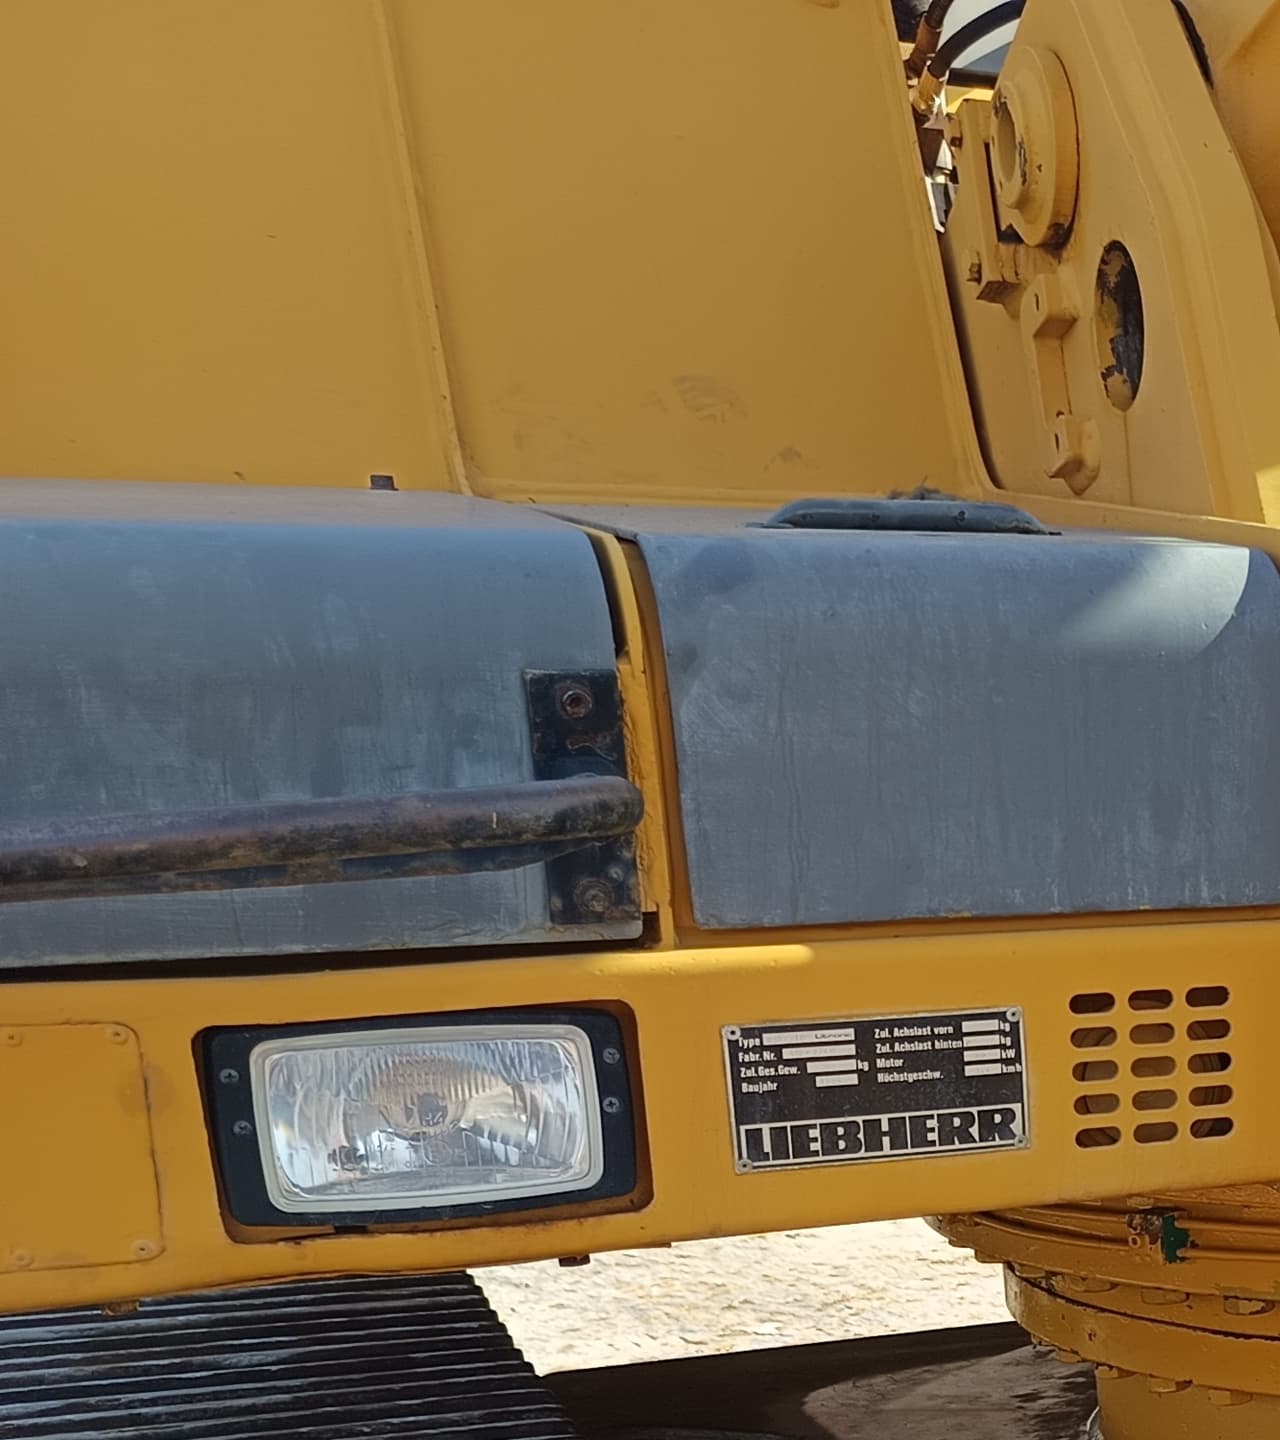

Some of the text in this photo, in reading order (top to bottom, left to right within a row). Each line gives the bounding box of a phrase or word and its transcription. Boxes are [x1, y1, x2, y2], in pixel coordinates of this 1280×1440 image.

[874, 1020, 1011, 1039] Zul. Achslast vorn kg
[738, 1037, 761, 1049] Type
[875, 1035, 1012, 1054] Zul. Achslast hinten kg
[857, 1060, 869, 1072] kg
[876, 1048, 1016, 1069] Motor kW
[877, 1069, 944, 1083] Höchstgeschw.
[741, 1081, 778, 1094] Baujahr
[745, 1107, 1016, 1162] LIEBHERR
